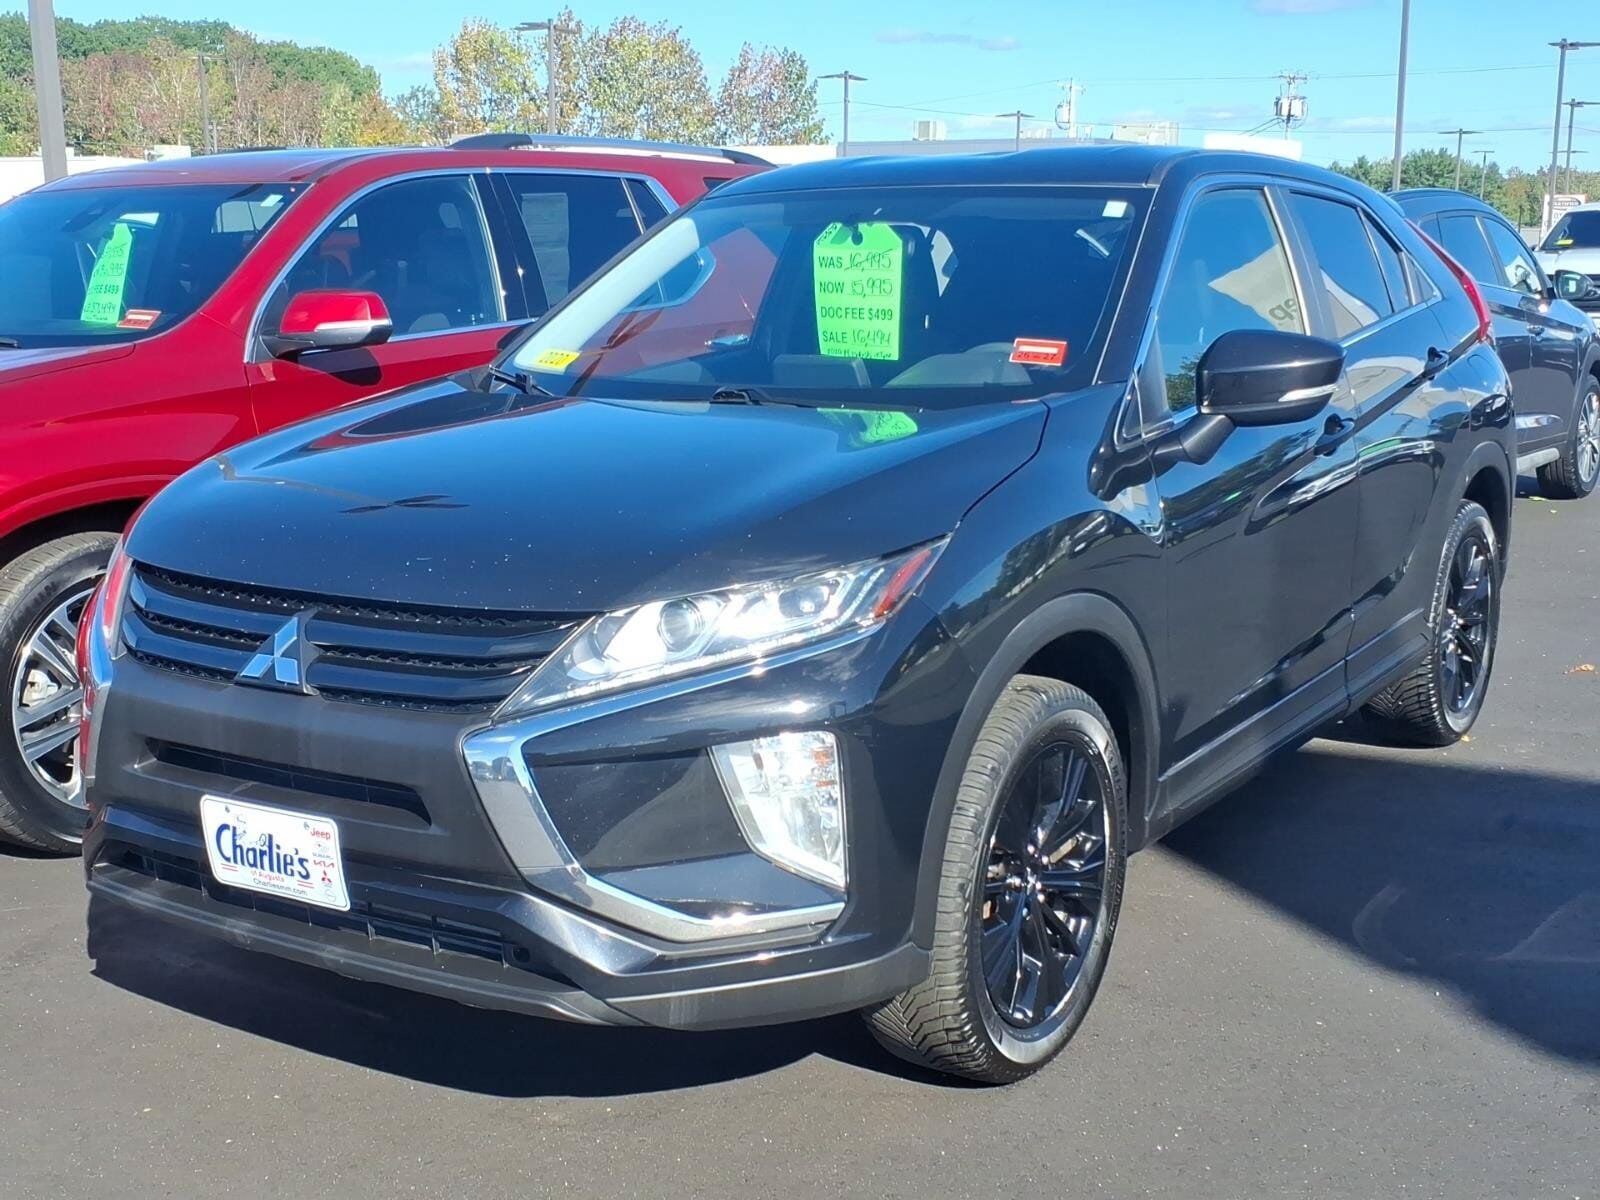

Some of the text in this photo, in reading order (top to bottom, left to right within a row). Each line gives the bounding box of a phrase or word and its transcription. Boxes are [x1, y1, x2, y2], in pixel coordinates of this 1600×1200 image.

[819, 256, 843, 269] WAS
[819, 281, 845, 294] NOW
[820, 306, 893, 321] DOC FEE $499
[822, 331, 848, 344] SALE
[310, 828, 331, 841] Jeep
[215, 823, 311, 880] Charlie's
